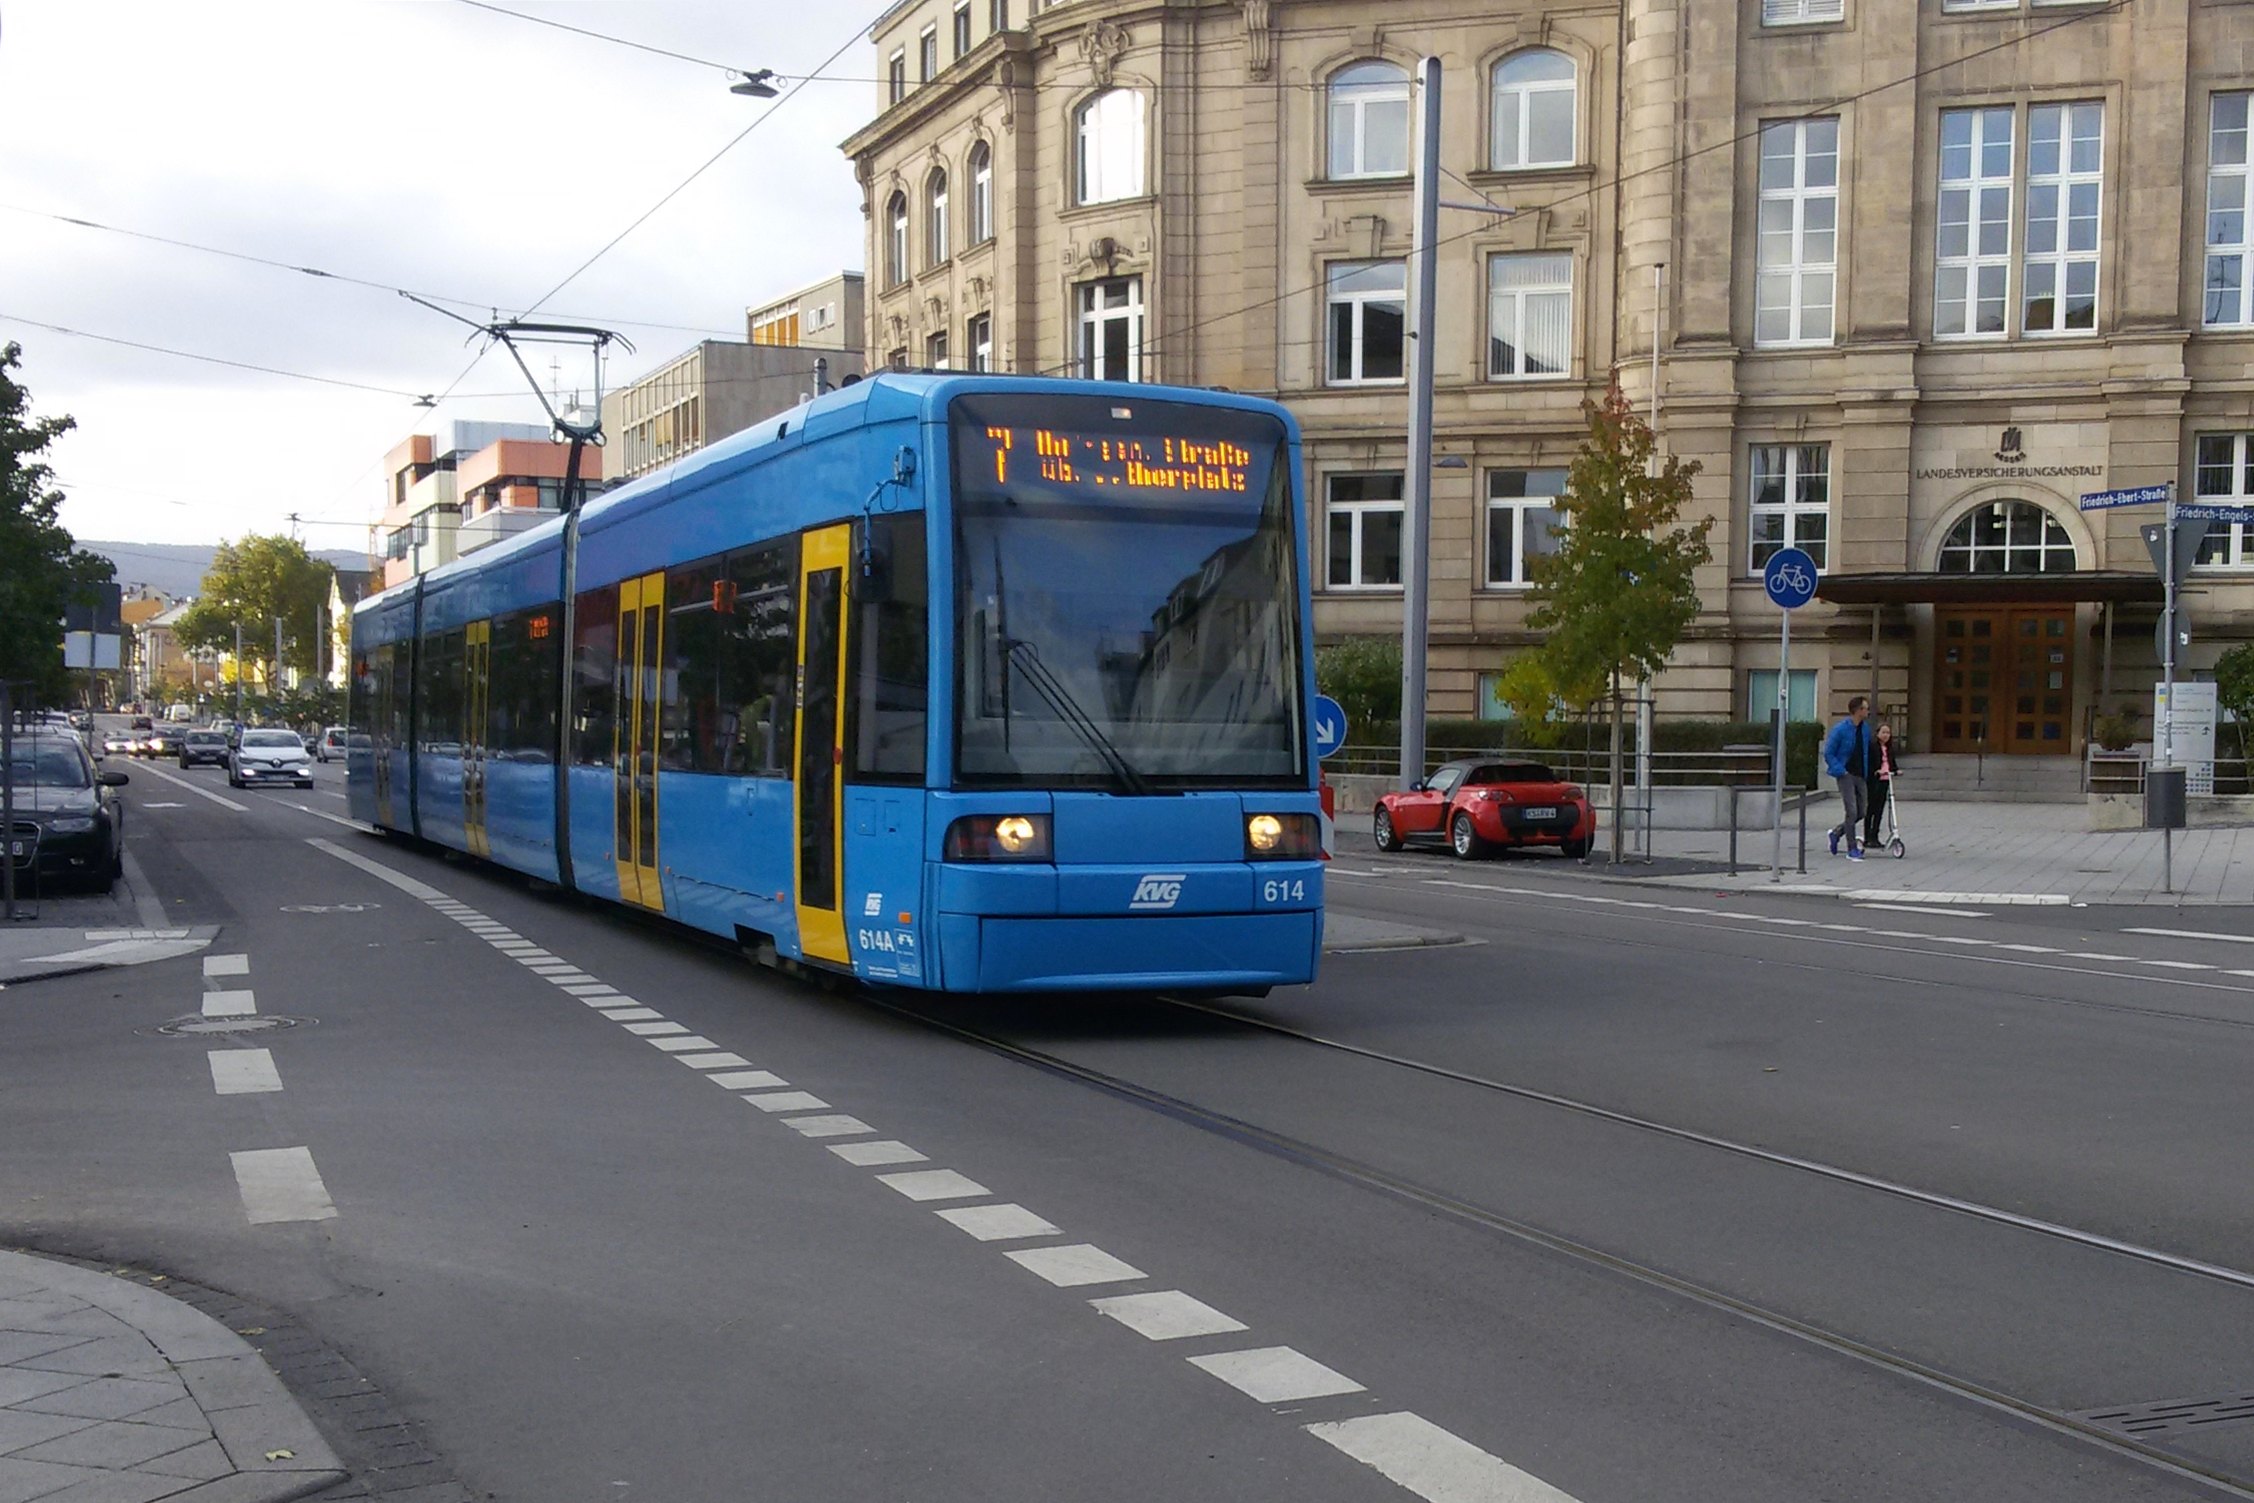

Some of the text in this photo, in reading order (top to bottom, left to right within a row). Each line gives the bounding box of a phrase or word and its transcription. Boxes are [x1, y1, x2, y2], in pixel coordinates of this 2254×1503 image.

[986, 426, 1013, 484] 7
[1917, 465, 2103, 479] LANDESVERSICHERUNGSANSTALT
[2080, 487, 2167, 508] Friedrich-Ebert-Straße
[1133, 882, 1181, 901] KVG
[1264, 880, 1305, 902] 614
[859, 929, 895, 952] 614A
